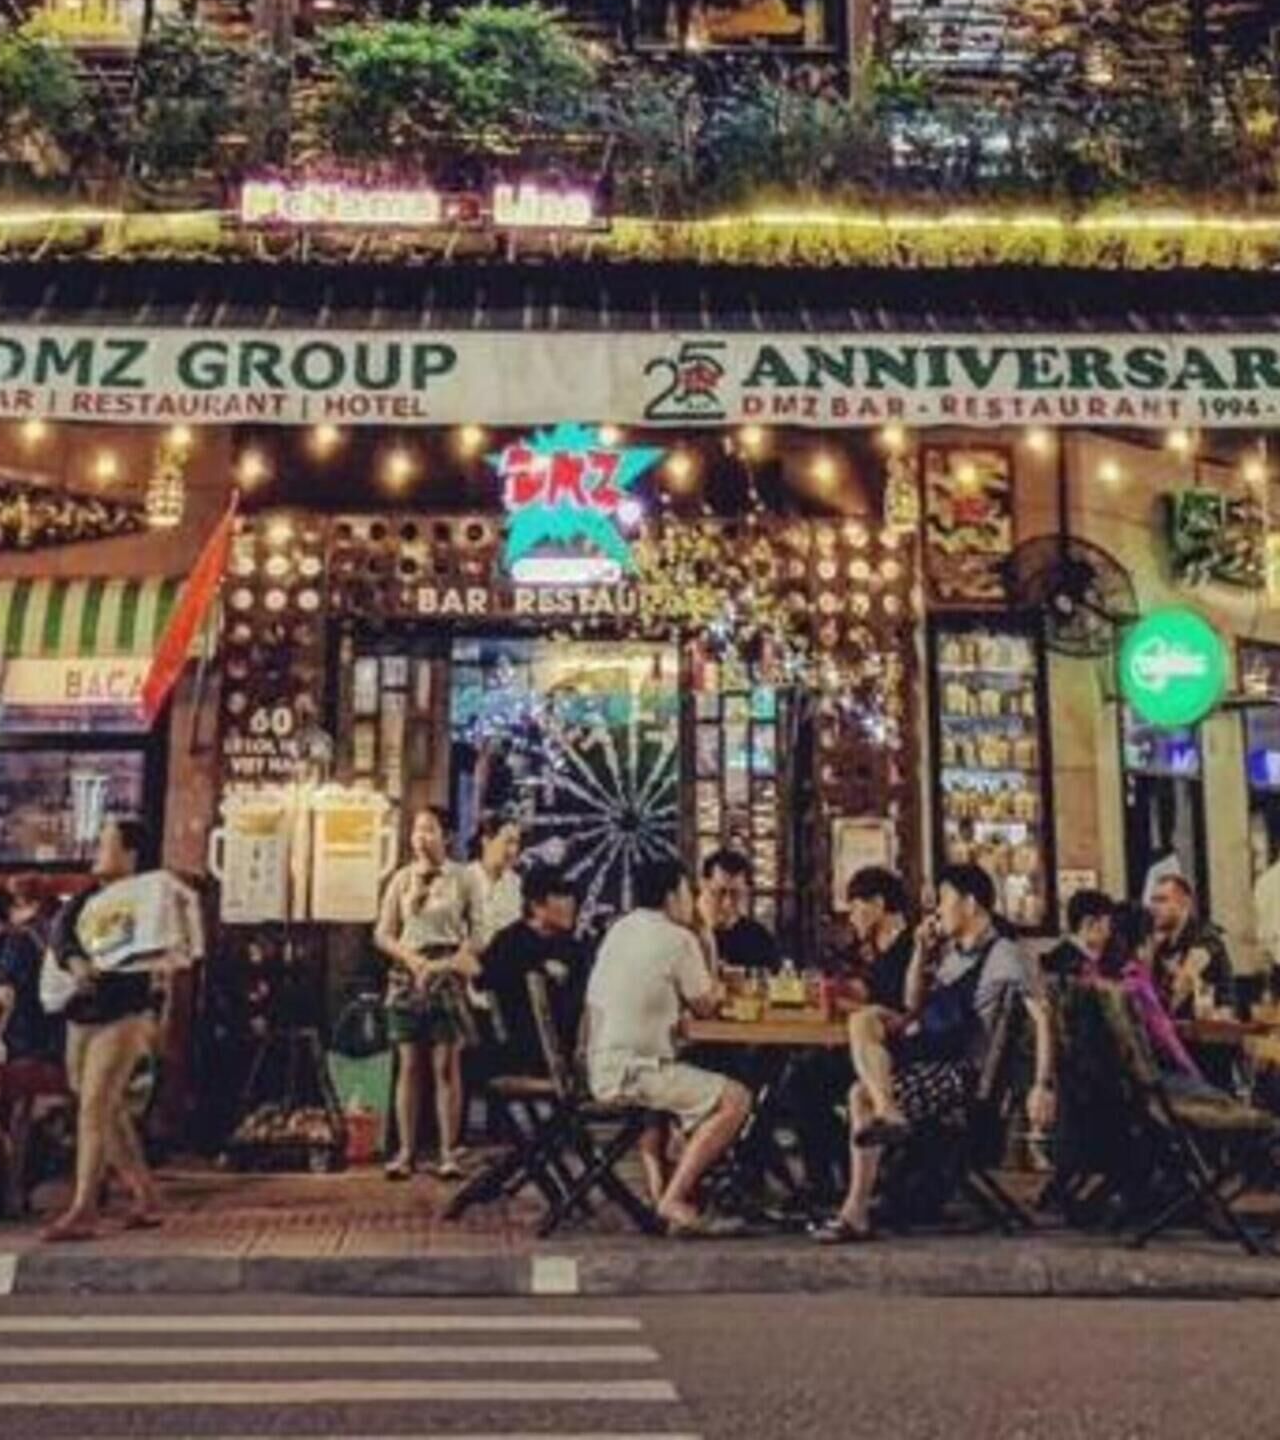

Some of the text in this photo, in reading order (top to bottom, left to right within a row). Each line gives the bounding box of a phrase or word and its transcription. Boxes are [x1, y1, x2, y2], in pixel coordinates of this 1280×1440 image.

[176, 341, 458, 390] GROUP
[644, 341, 727, 420] 25
[71, 392, 288, 417] RESTAURANT
[323, 394, 429, 418] HOTEL
[830, 396, 905, 418] BAR
[940, 396, 1182, 420] RESTAURANT
[417, 586, 680, 614] BAR RESTAU
[249, 707, 294, 736] 60
